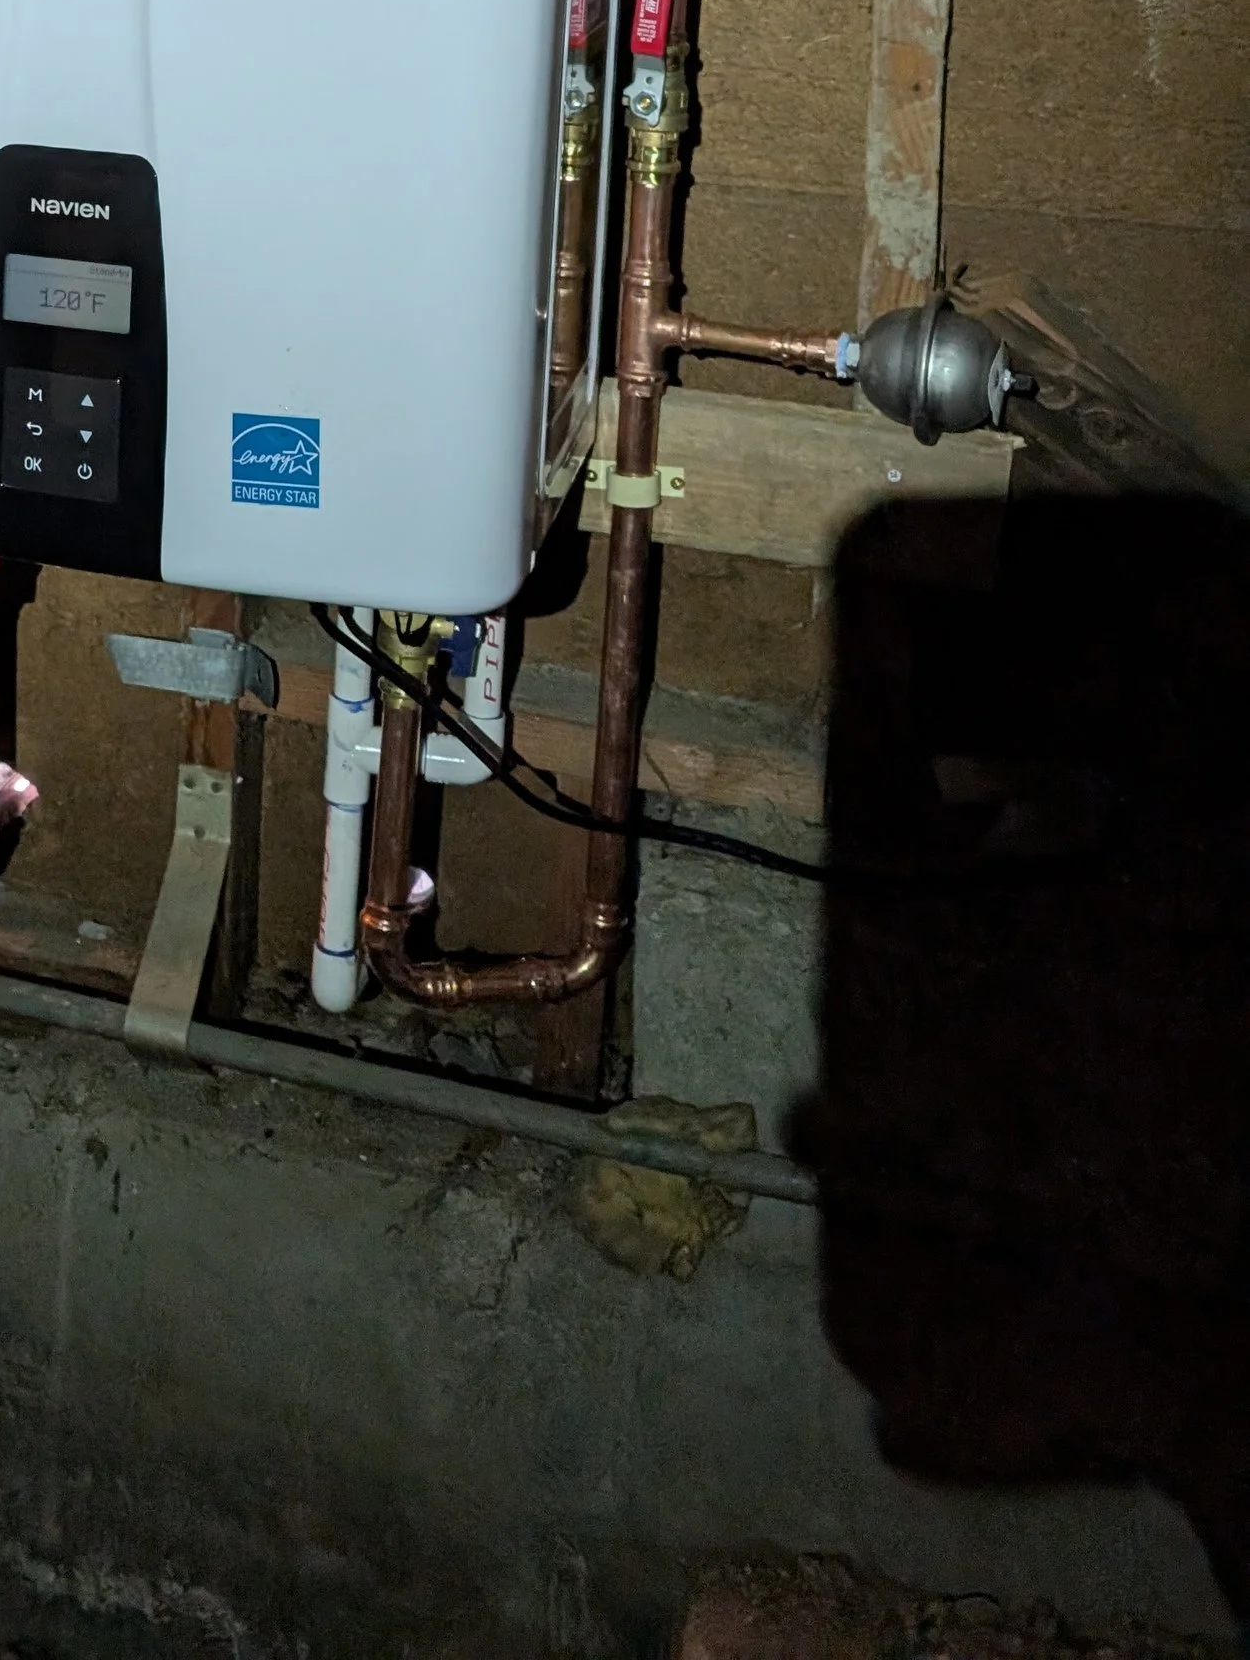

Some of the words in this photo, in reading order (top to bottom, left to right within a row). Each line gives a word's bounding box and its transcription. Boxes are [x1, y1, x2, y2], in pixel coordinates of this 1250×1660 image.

[28, 387, 43, 402] M
[24, 456, 42, 472] OK
[233, 449, 303, 474] energy
[234, 485, 283, 502] ENERGY
[285, 489, 317, 505] STAR
